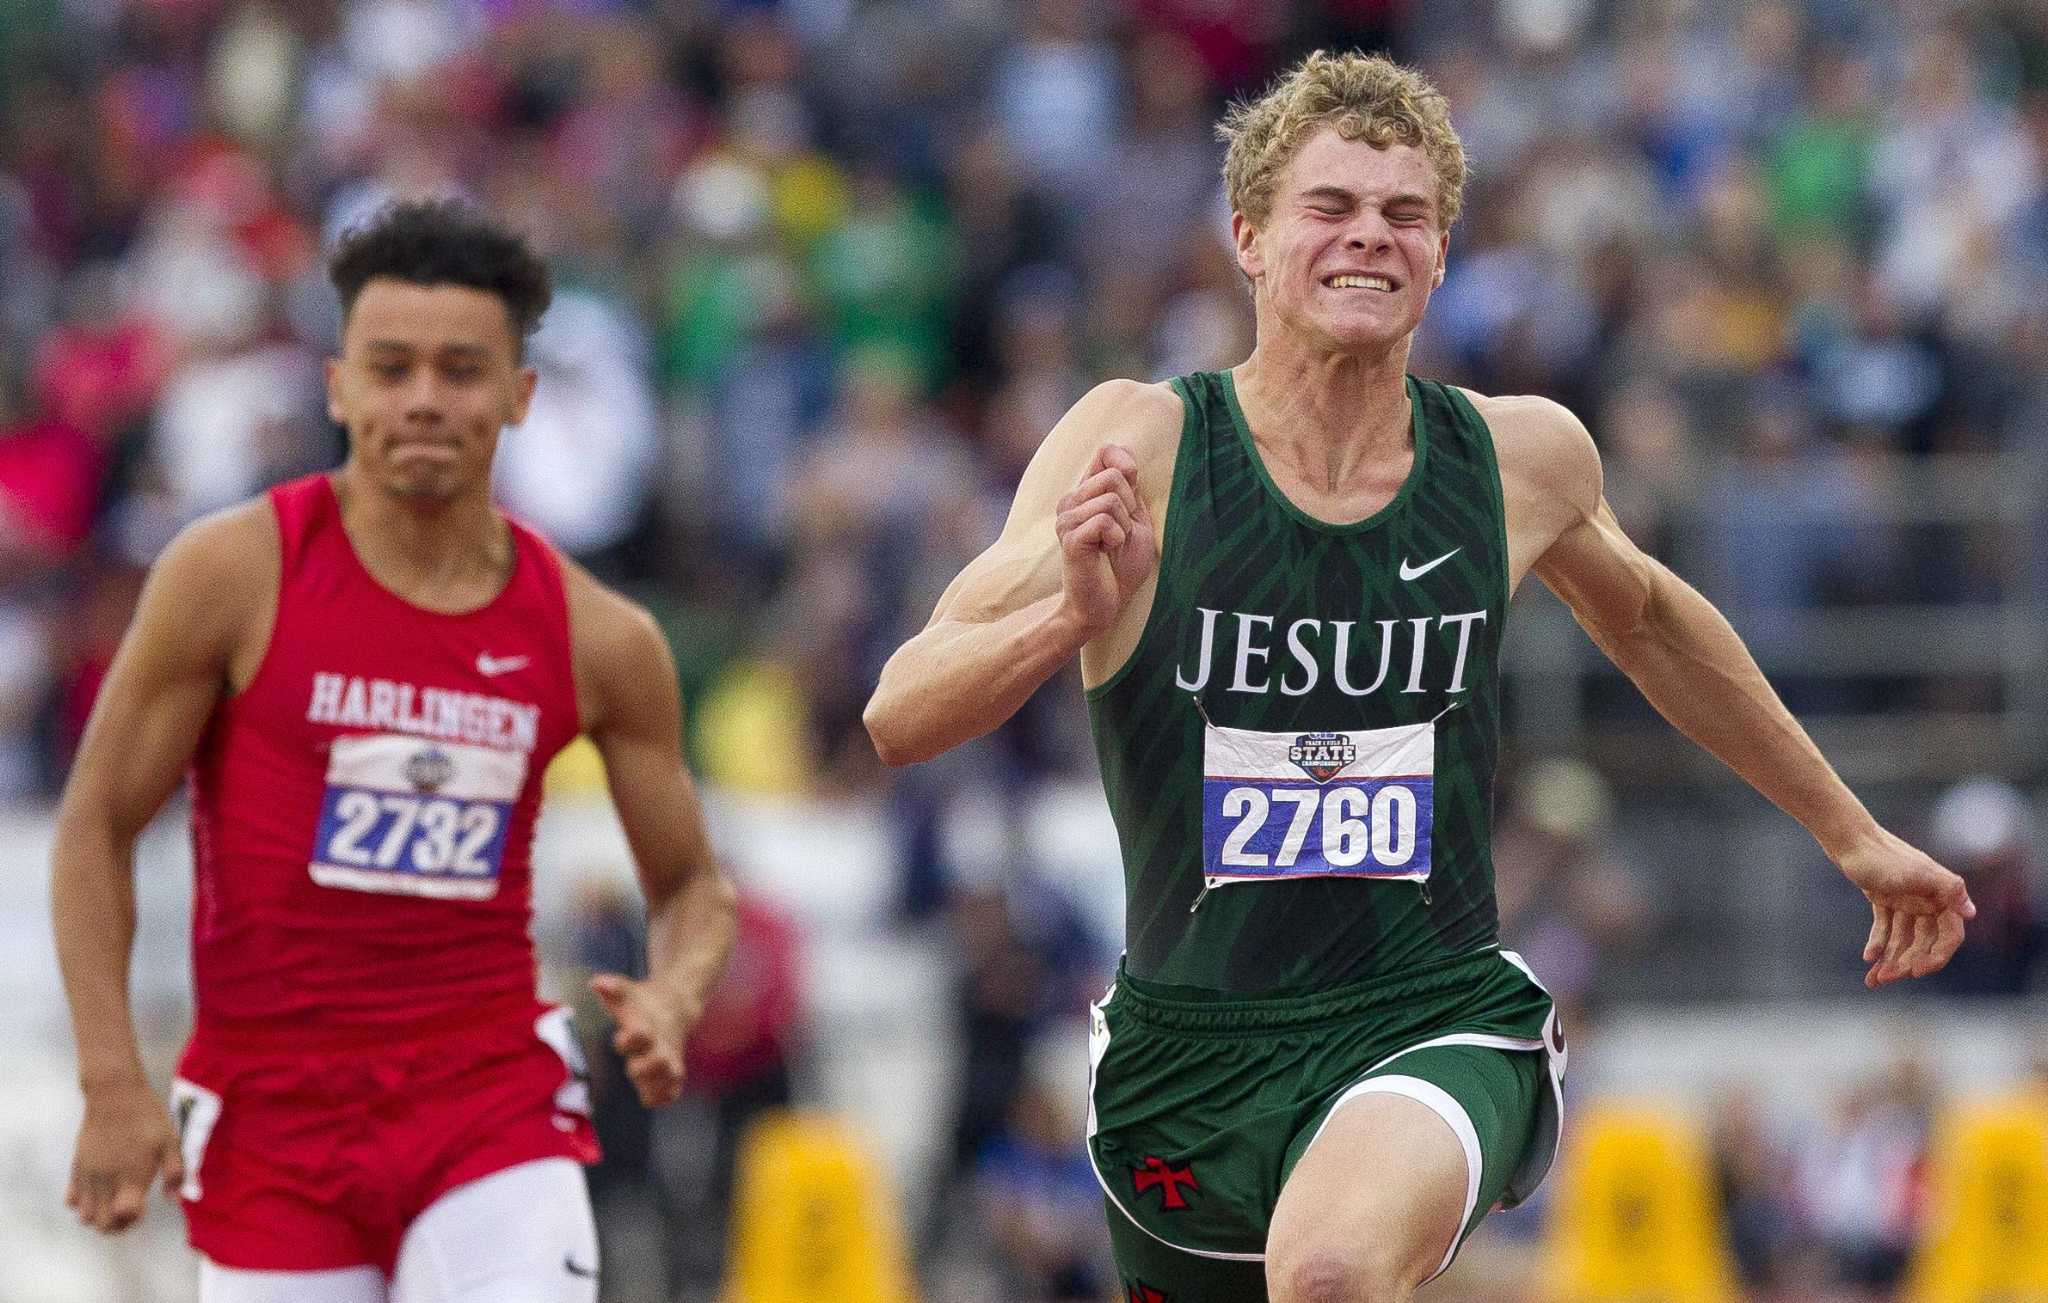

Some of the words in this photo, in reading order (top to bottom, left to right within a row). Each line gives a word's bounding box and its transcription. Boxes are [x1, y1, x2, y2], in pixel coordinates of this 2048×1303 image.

[1176, 607, 1487, 696] JESUIT
[307, 673, 540, 750] HARLINGEN
[1290, 746, 1354, 760] STATE
[329, 792, 499, 875] 2732
[1222, 786, 1417, 867] 2760
